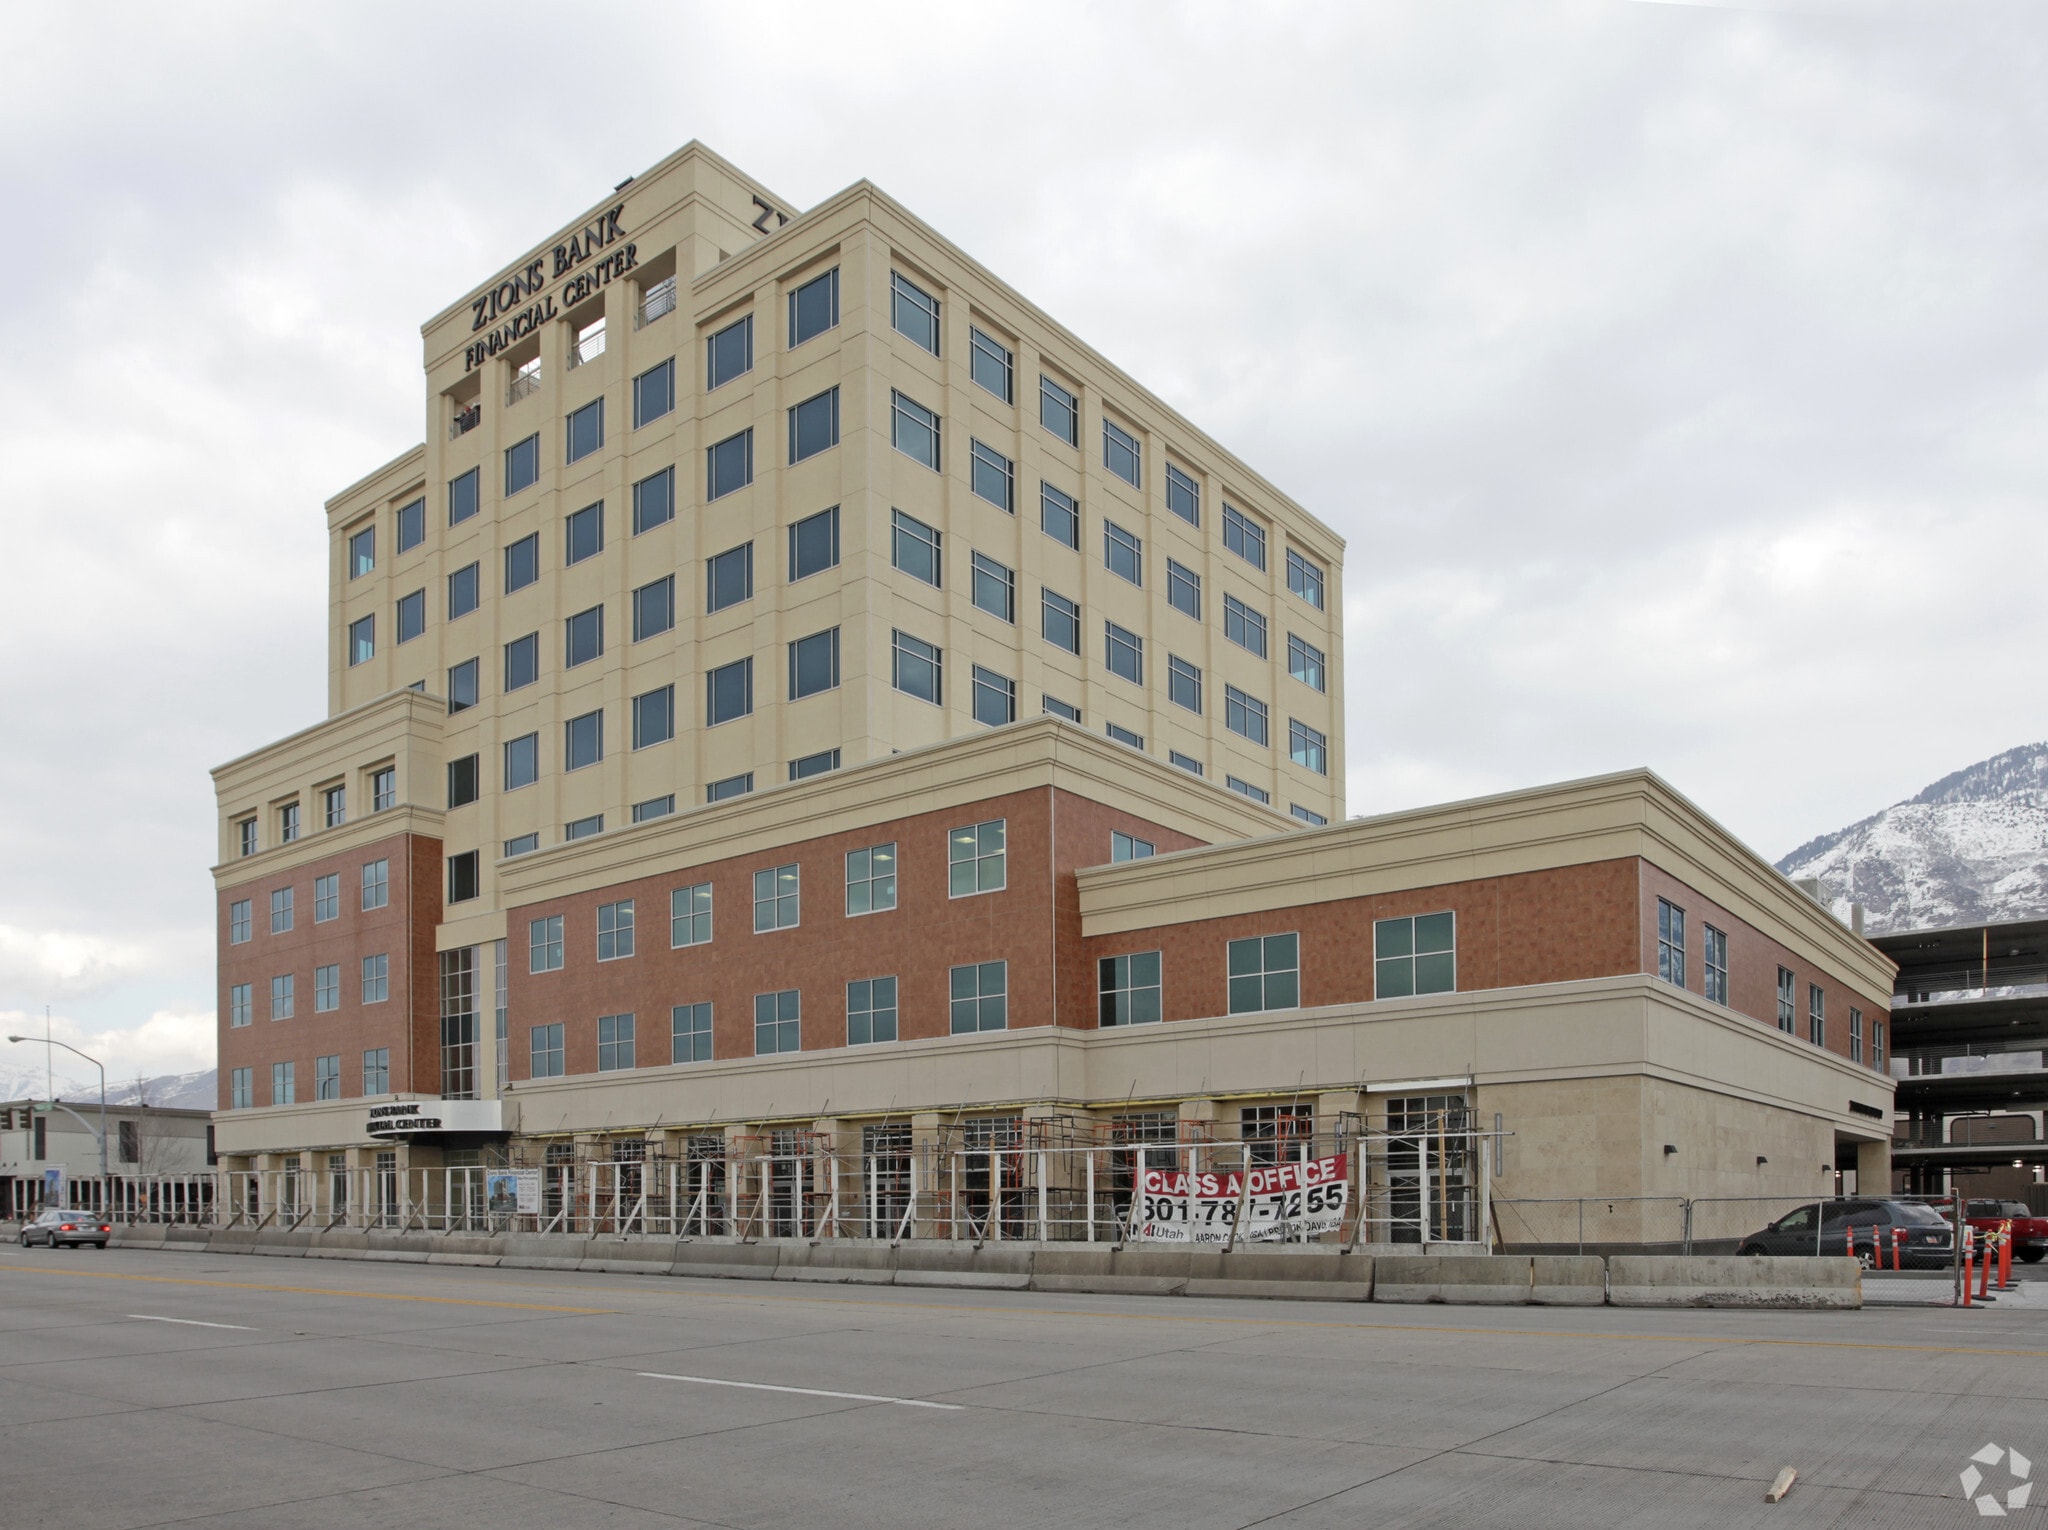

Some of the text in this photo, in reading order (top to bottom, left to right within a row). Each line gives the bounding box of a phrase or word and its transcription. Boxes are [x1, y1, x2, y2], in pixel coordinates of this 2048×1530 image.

[472, 203, 626, 332] ZIONS BANK
[465, 243, 638, 372] FINANCIAL CENTER
[396, 1118, 443, 1129] CENTER
[1144, 1157, 1336, 1197] CLASS A OFFICE
[1156, 1227, 1184, 1240] Utah
